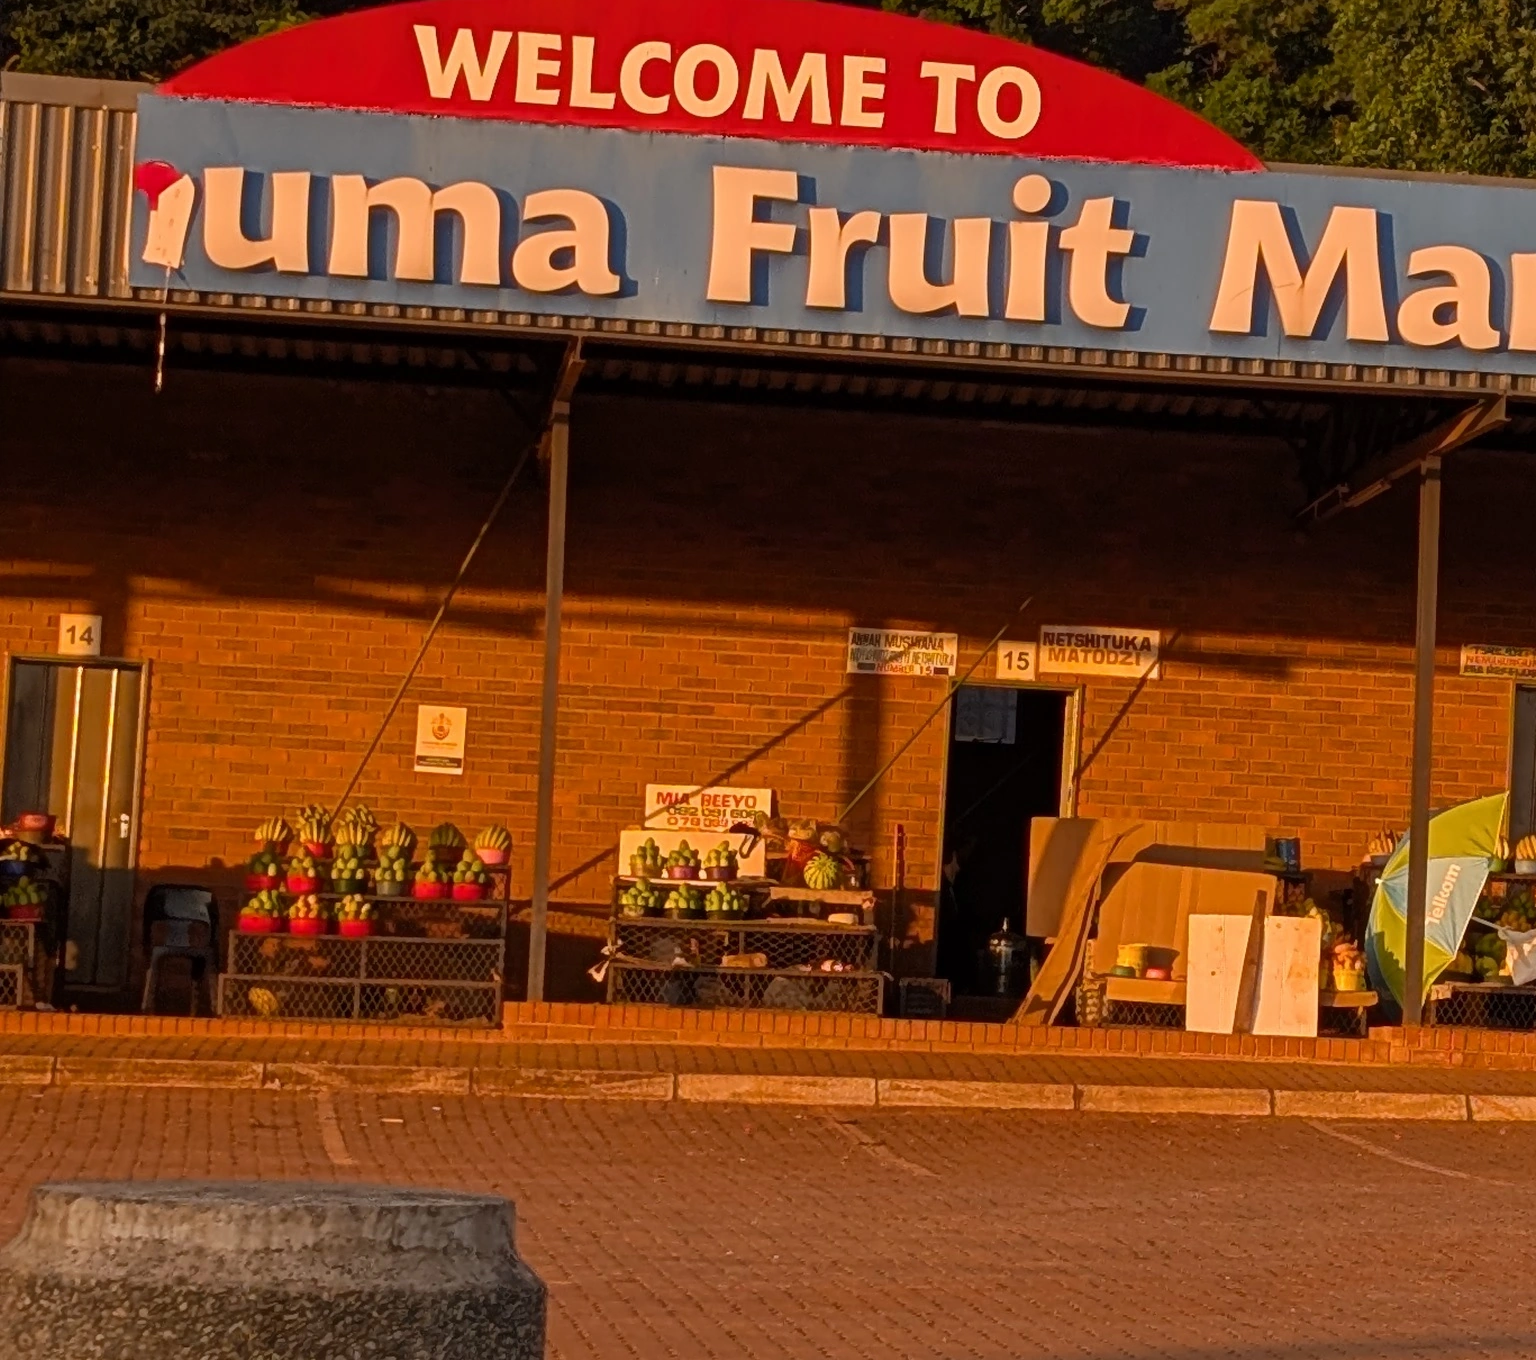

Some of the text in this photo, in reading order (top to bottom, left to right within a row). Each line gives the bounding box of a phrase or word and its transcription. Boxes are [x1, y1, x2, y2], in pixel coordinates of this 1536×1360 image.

[413, 24, 1042, 140] WELCOME TO
[706, 164, 1135, 329] Fruit
[66, 624, 93, 646] 14
[1042, 632, 1152, 652] NETSHITUKA
[1003, 650, 1030, 671] 15
[1048, 648, 1142, 667] MATODZI
[1425, 863, 1461, 925] Telkom
